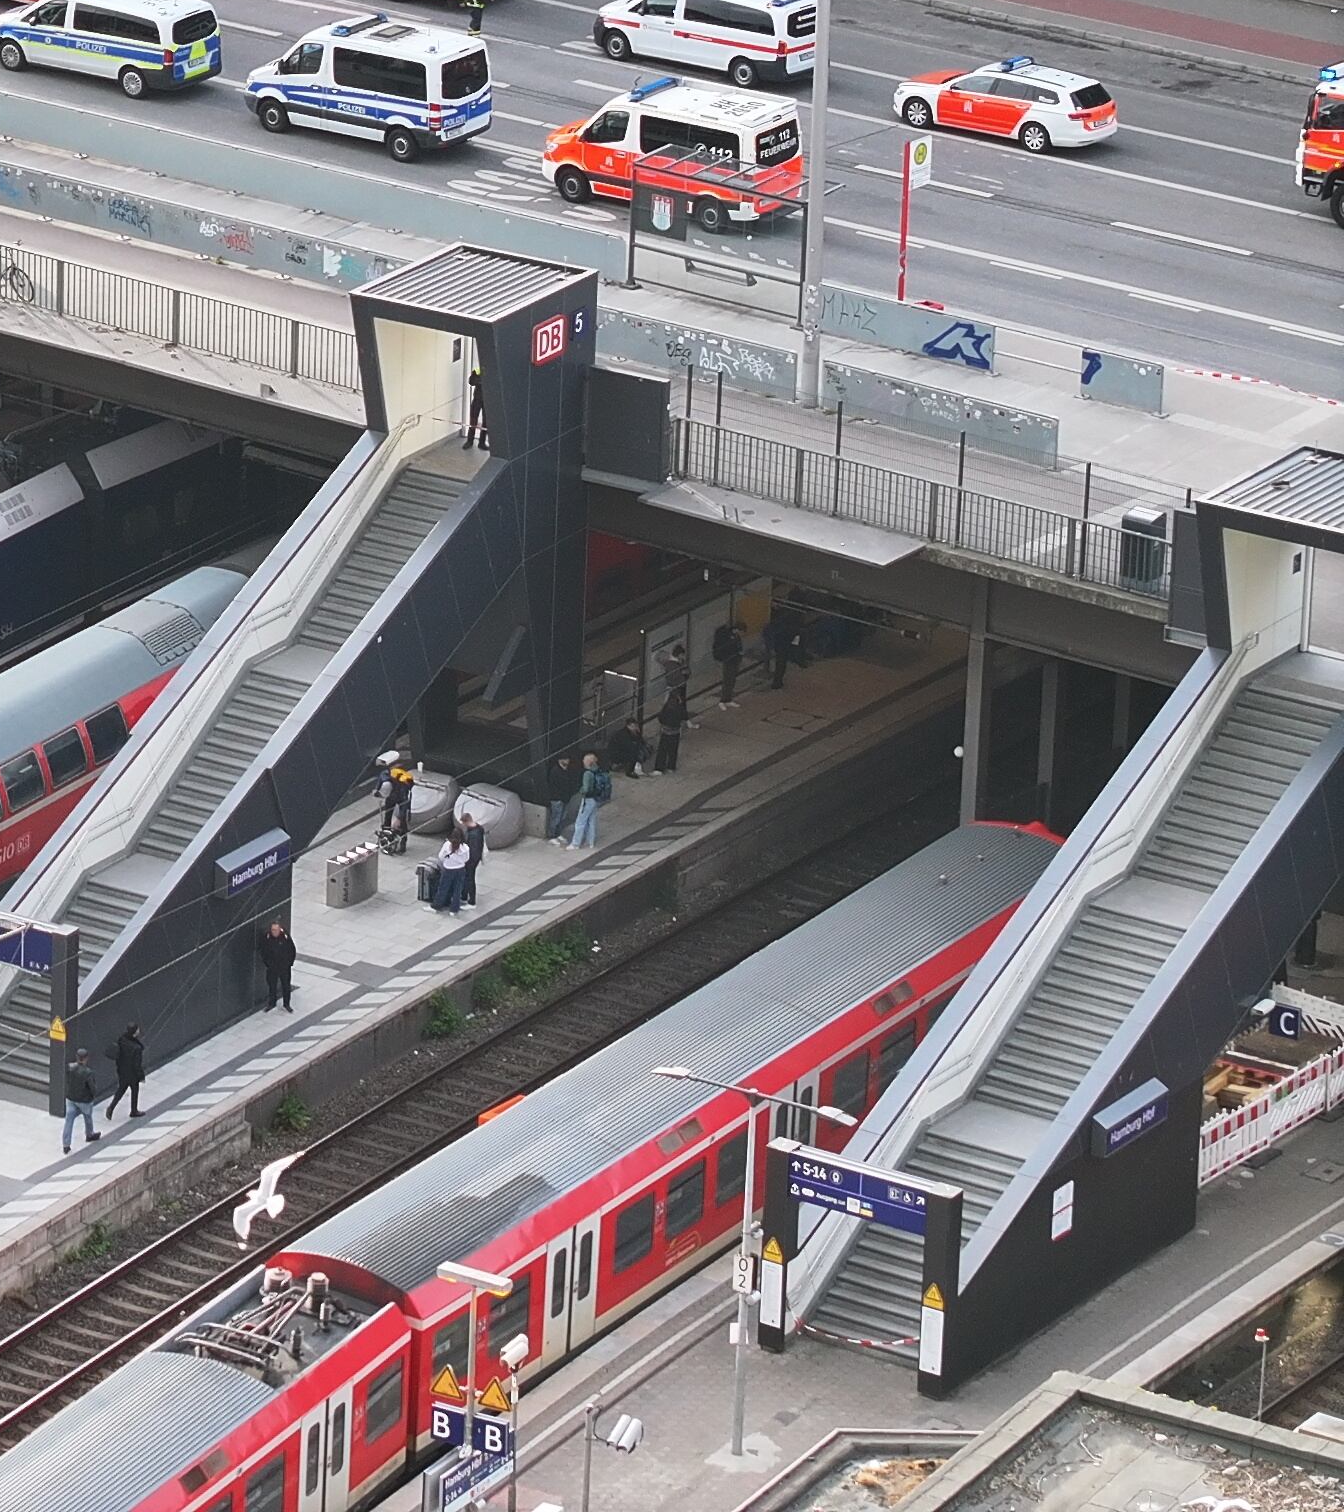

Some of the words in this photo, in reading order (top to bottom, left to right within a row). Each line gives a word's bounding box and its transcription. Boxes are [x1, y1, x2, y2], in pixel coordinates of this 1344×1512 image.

[76, 40, 107, 55] POLIZEI
[778, 128, 790, 142] 112
[539, 325, 560, 357] DB
[575, 312, 583, 334] 5
[232, 862, 263, 888] Hamburg
[264, 851, 278, 870] Hbf
[1280, 1012, 1295, 1035] C
[1110, 1117, 1141, 1145] Hamburg
[1142, 1105, 1156, 1124] Hbf
[803, 1162, 826, 1181] 5-14
[738, 1274, 748, 1291] 2
[432, 1410, 448, 1437] B
[484, 1424, 501, 1451] B
